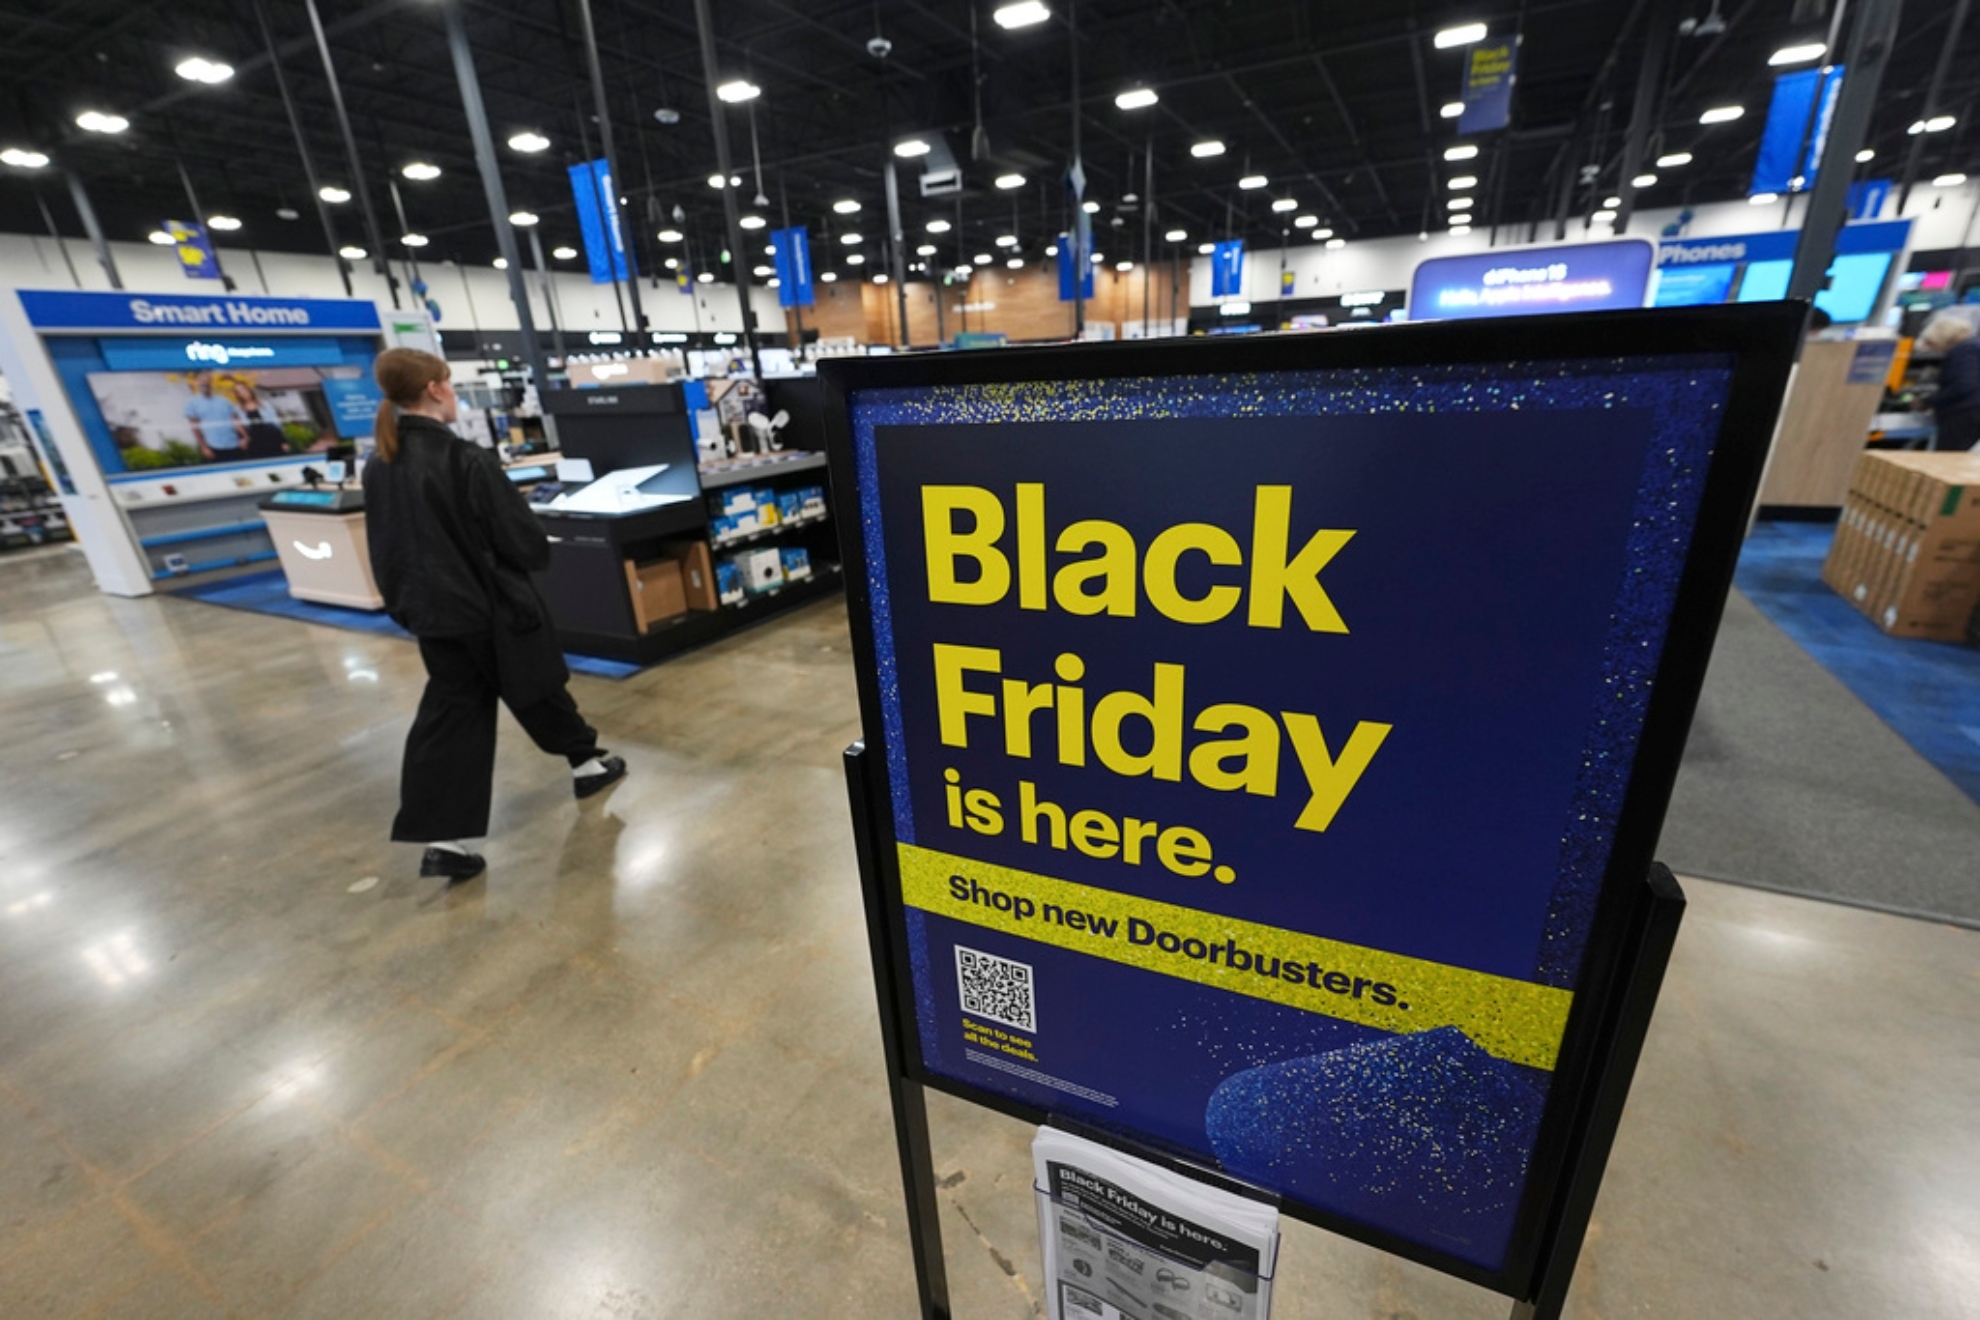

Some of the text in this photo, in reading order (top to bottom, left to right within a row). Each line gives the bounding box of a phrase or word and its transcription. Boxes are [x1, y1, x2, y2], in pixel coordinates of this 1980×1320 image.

[130, 300, 310, 325] Smart Home
[921, 482, 1358, 634] Black
[933, 643, 1394, 832] Friday
[943, 767, 1237, 885] is here.
[948, 875, 1410, 1010] Shop new Doorbusters.
[962, 1018, 1033, 1049] Scan to see
[964, 1032, 1039, 1062] all the deals.
[1059, 1168, 1105, 1195] Black
[1107, 1188, 1158, 1224] Friday
[1161, 1215, 1176, 1231] is
[1179, 1223, 1227, 1252] here.
